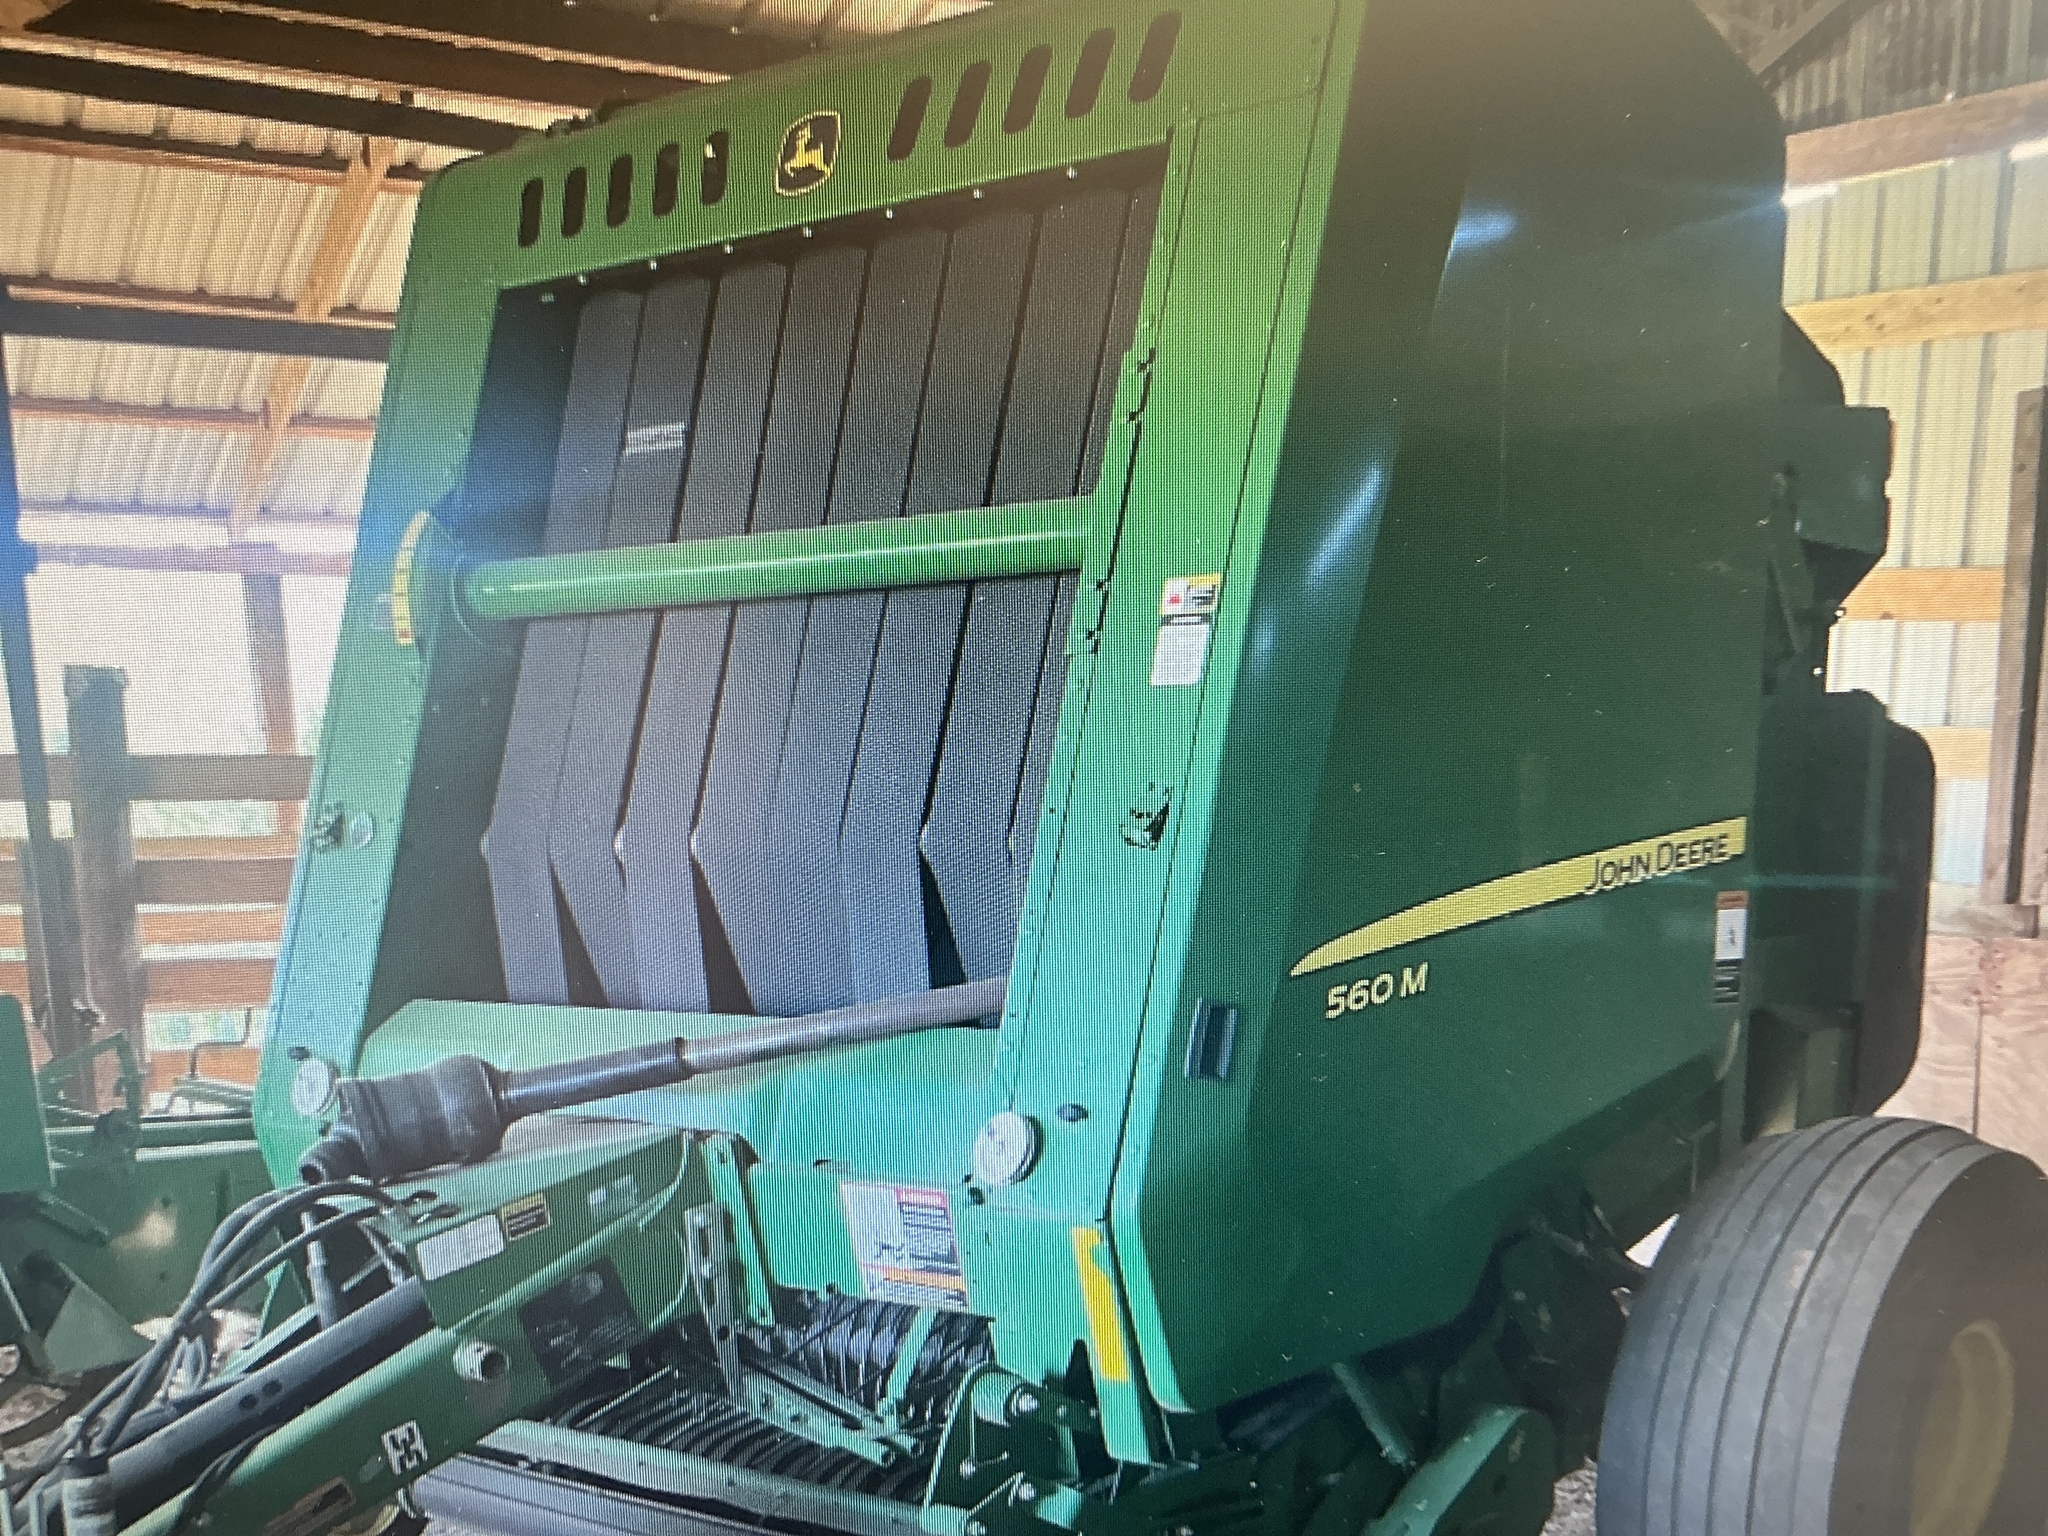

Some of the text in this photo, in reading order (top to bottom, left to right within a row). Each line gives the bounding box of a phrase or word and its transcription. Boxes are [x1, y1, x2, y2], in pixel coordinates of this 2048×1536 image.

[1588, 834, 1729, 893] JOHN DEERE
[1325, 962, 1429, 1019] 560 M
